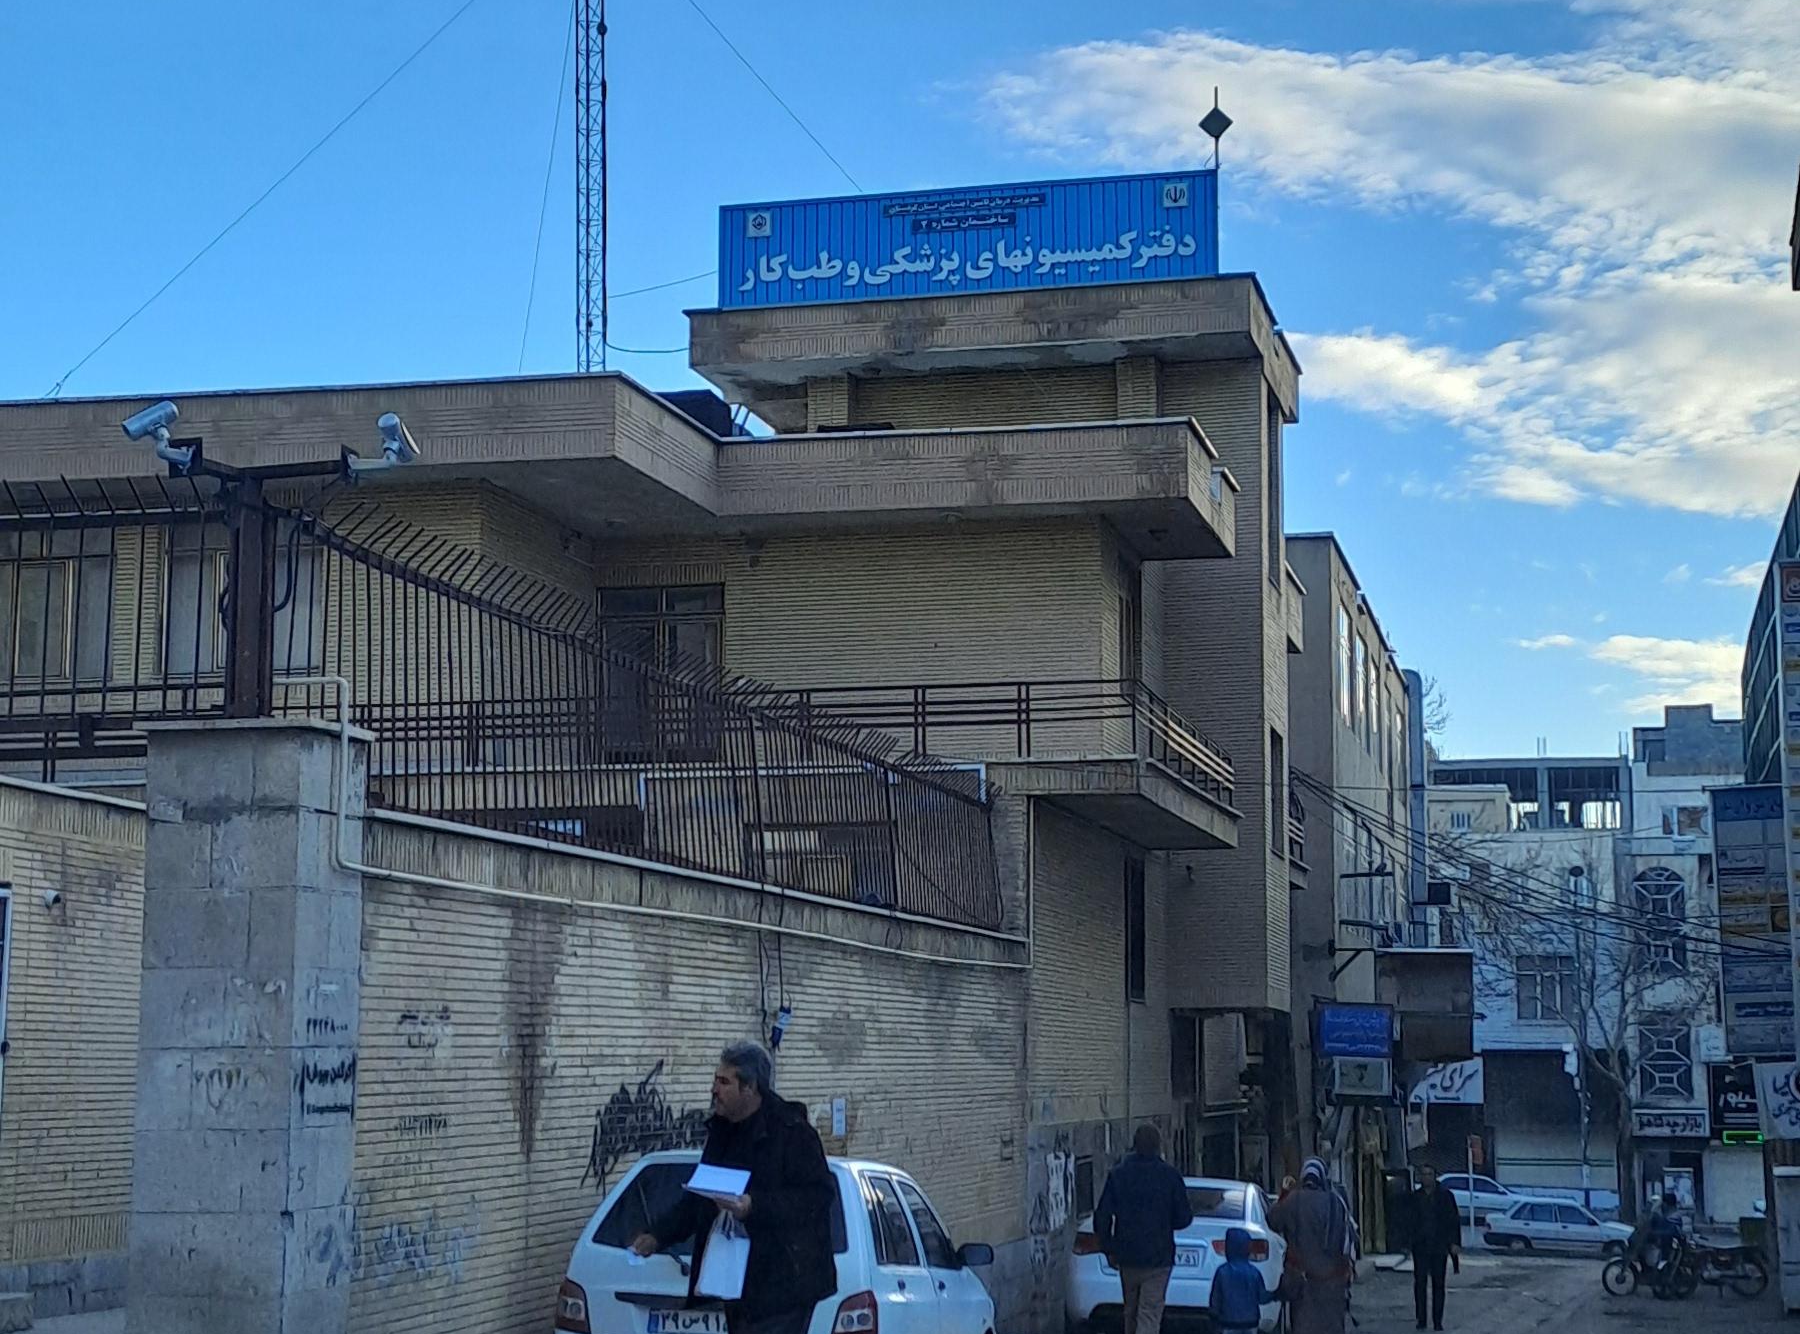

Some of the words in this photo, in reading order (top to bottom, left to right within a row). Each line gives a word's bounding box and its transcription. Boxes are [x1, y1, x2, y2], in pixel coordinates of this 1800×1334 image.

[931, 217, 958, 230] شماره
[960, 214, 1009, 228] ساختمان
[863, 243, 960, 286] پزشکی
[965, 229, 1138, 280] کمیسیونهای
[1131, 224, 1196, 268] دفتر
[738, 253, 788, 292] کار
[787, 250, 843, 290] طب
[843, 259, 861, 286] و
